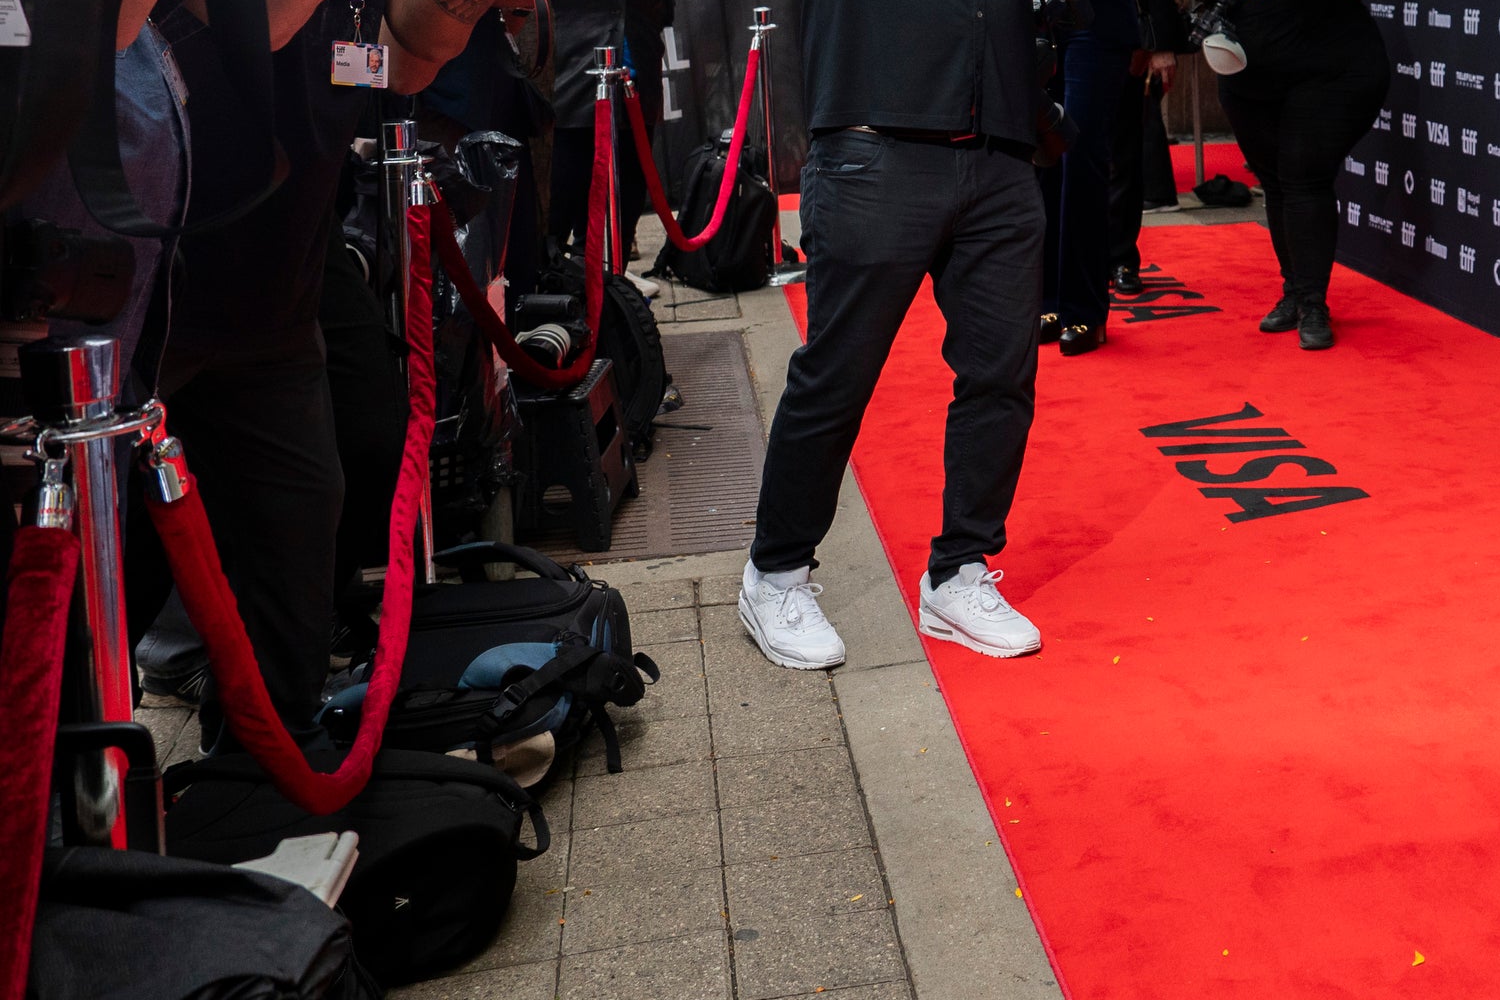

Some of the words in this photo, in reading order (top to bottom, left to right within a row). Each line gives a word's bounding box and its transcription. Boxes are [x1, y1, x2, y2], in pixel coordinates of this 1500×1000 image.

[1403, 2, 1418, 26] tiff
[1427, 121, 1449, 146] VISA
[1348, 202, 1360, 226] tiff
[1402, 221, 1415, 247] tiff
[1138, 401, 1371, 524] VISA
